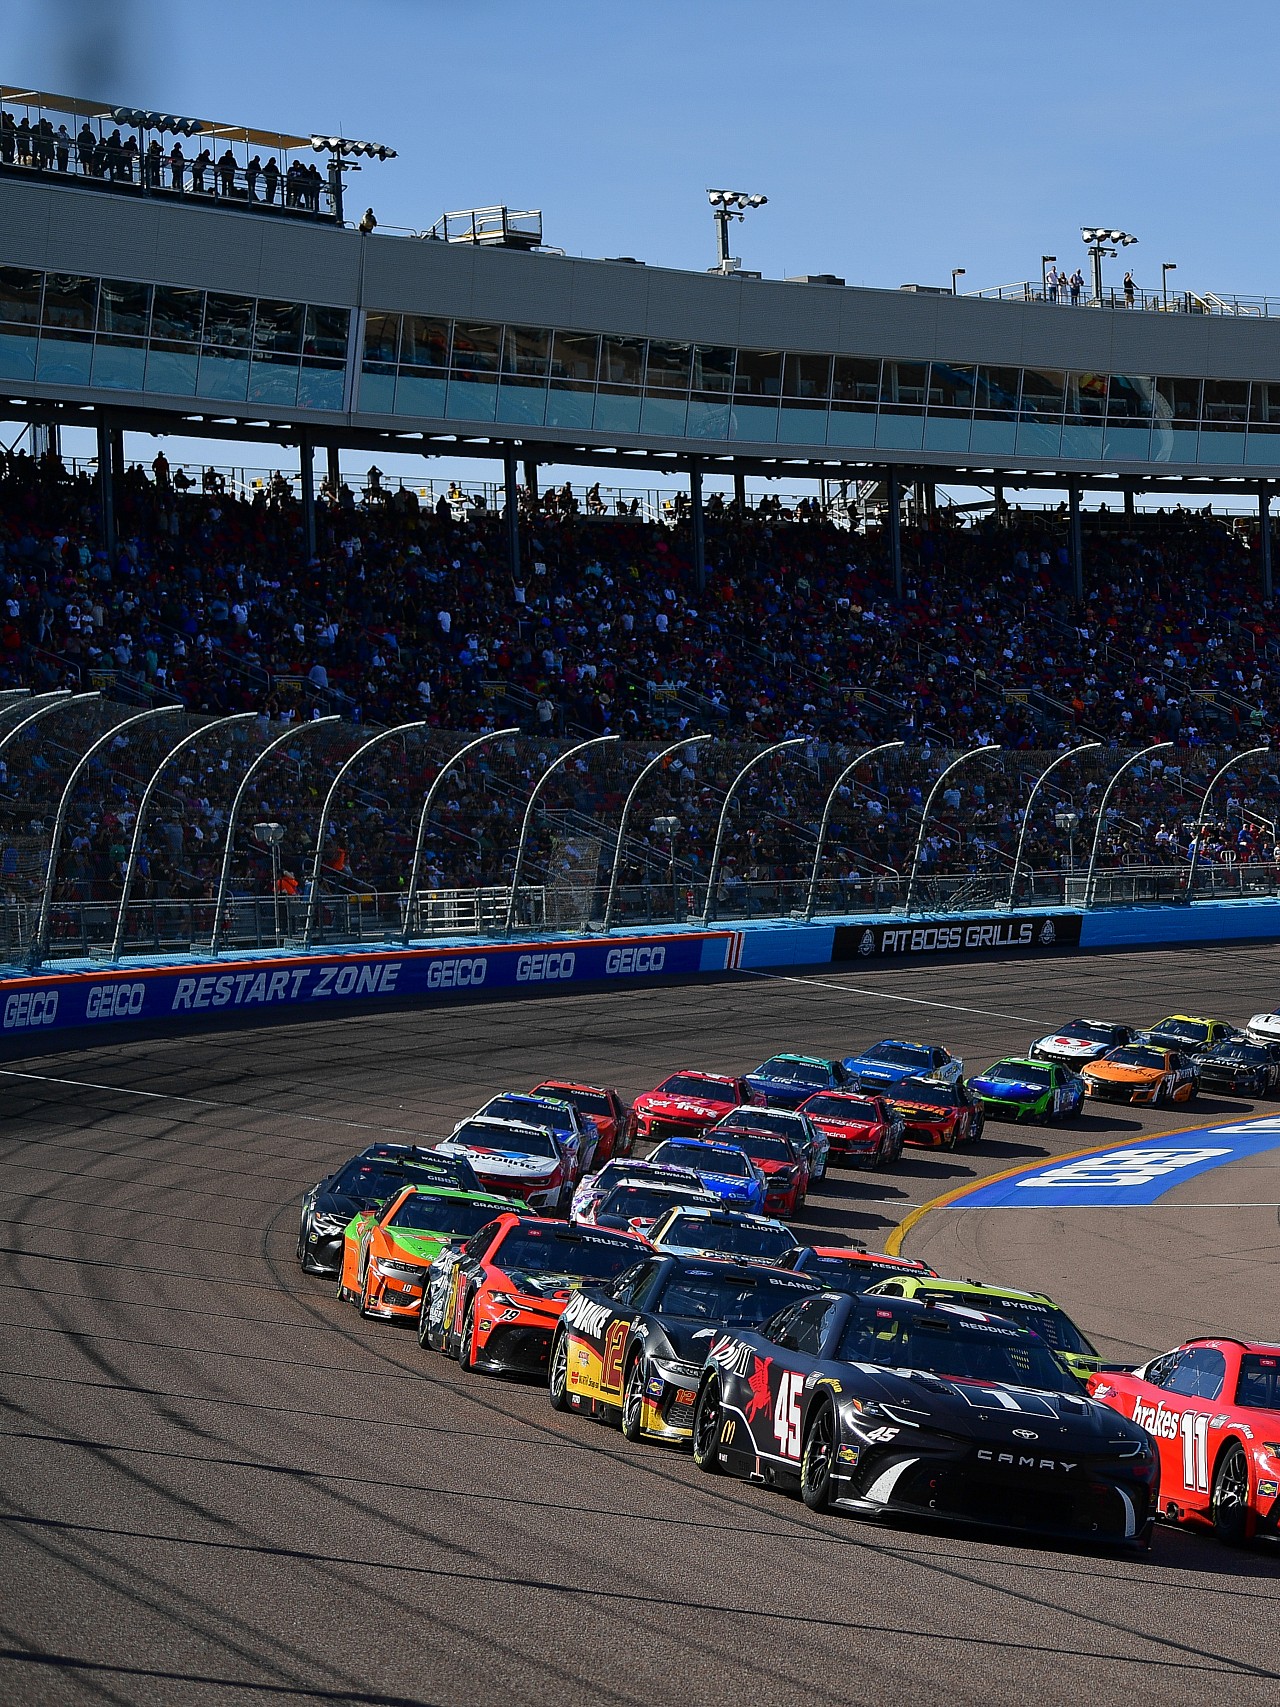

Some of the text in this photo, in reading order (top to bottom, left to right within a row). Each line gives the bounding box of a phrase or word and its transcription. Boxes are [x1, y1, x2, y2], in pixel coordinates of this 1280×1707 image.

[965, 923, 1033, 946] GRILLS
[516, 952, 575, 981] GEICO
[606, 946, 666, 974] GEICO
[427, 958, 487, 988] GEICO
[172, 963, 402, 1010] RESTART ZONE
[3, 991, 58, 1027] GEICO
[86, 983, 145, 1019] GEICO
[509, 1128, 540, 1136] LARSON
[421, 1156, 457, 1166] WALLACE
[654, 1170, 692, 1180] BOWMAN
[472, 1201, 521, 1213] GRAGSON
[740, 1223, 780, 1234] ELLIOTT
[582, 1235, 630, 1249] TRUEX
[402, 1284, 412, 1292] 10
[769, 1278, 821, 1291] BLANEY
[1002, 1300, 1047, 1313] BYRON
[500, 1309, 521, 1322] 19
[959, 1321, 1021, 1337] REDDICK
[601, 1319, 631, 1391] 12
[675, 1389, 697, 1406] 12
[774, 1370, 806, 1460] 45
[1131, 1396, 1180, 1440] brakes
[865, 1426, 901, 1442] 45
[977, 1449, 1078, 1472] CAMRY
[1180, 1410, 1213, 1494] 11
